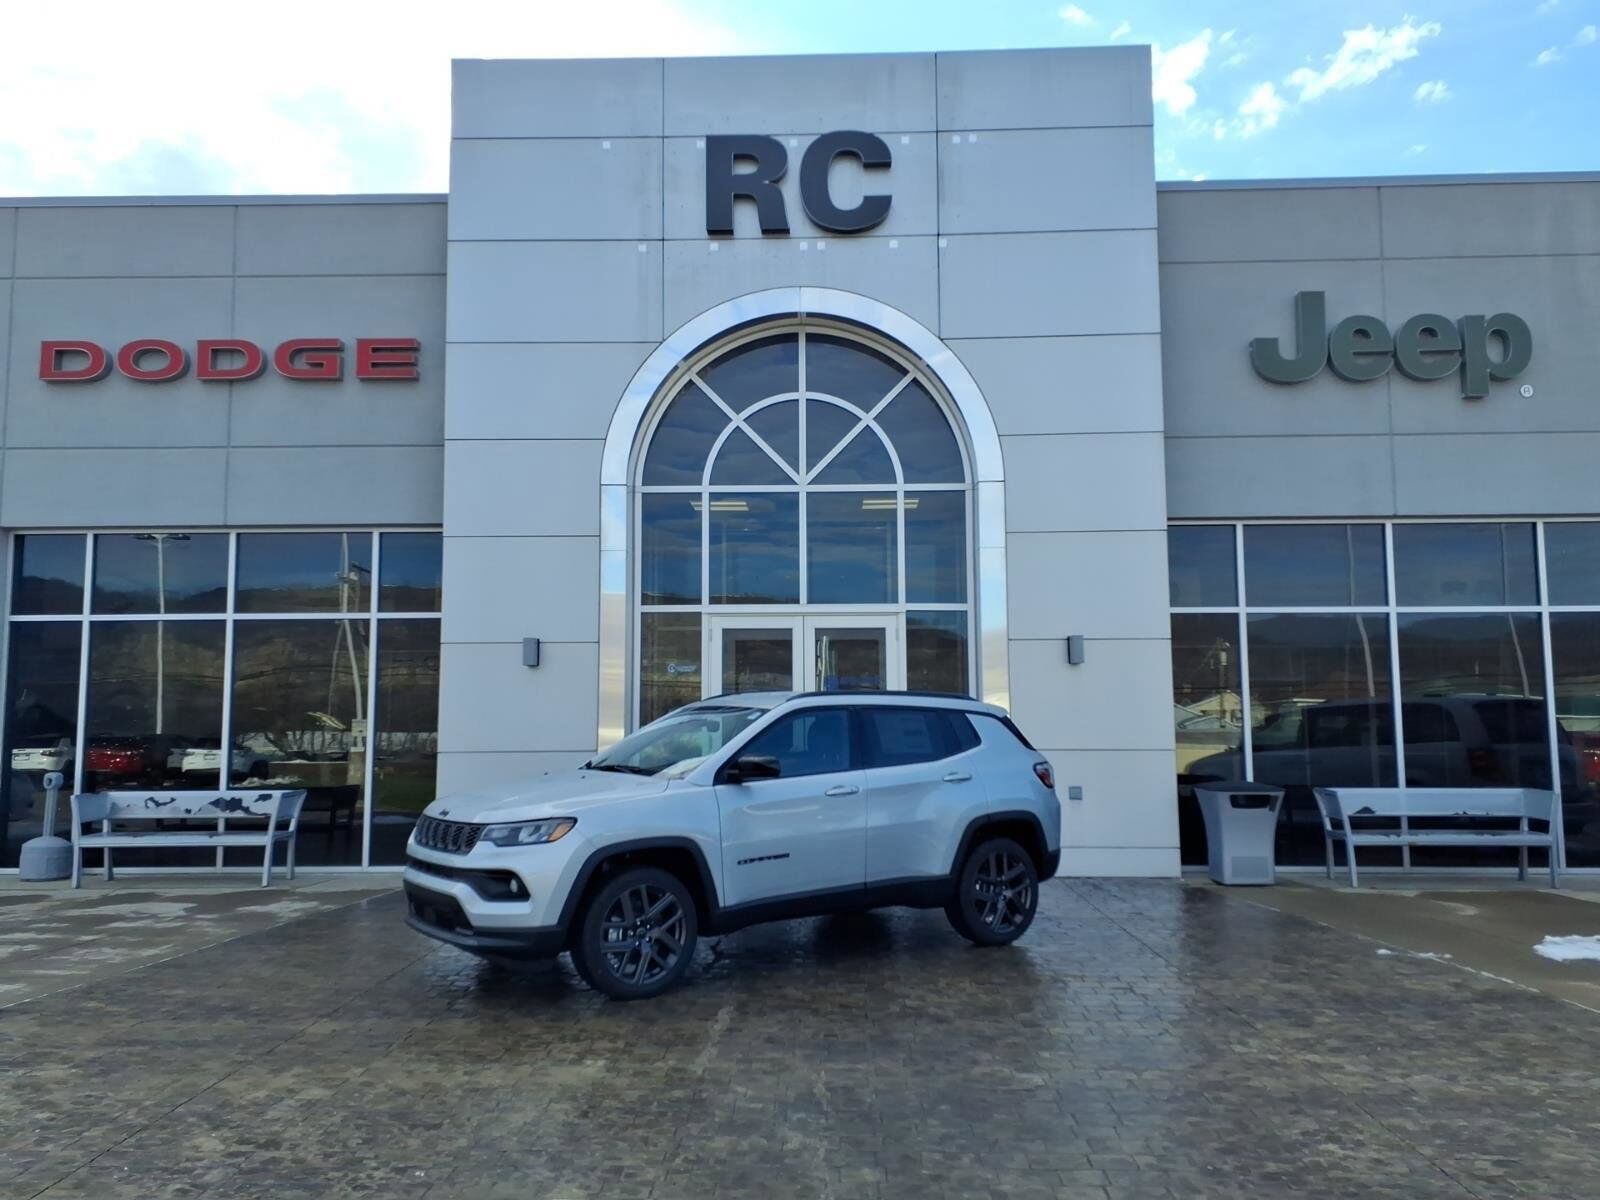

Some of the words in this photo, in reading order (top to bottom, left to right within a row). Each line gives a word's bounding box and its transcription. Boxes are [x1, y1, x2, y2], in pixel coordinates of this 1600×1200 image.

[706, 130, 892, 235] RC
[39, 337, 421, 382] DODGE
[1249, 290, 1533, 400] Jeep
